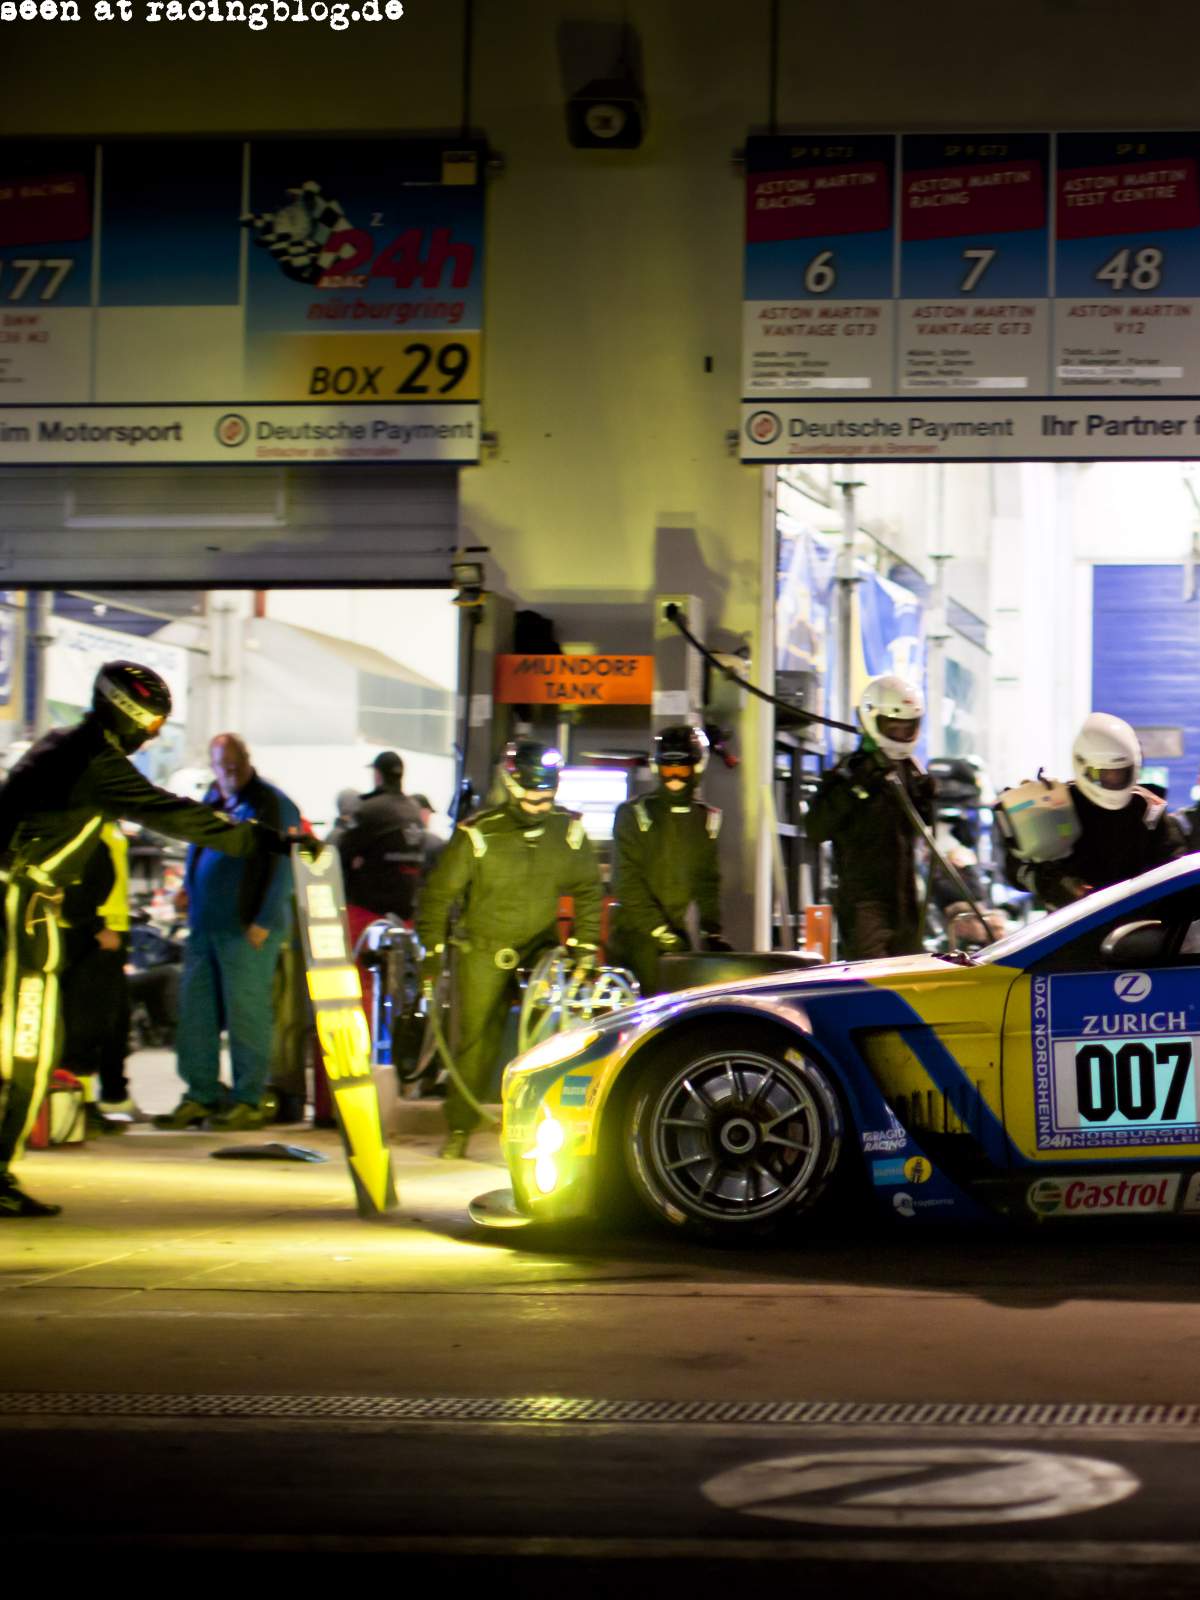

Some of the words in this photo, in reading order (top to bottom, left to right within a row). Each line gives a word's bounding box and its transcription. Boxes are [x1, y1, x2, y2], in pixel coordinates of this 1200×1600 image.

[756, 178, 809, 195] ASTON
[815, 171, 879, 189] MARTIN
[909, 177, 962, 192] ASTON
[968, 170, 1032, 187] MARTIN
[1063, 175, 1118, 191] ASTON
[1123, 169, 1187, 186] MARTIN
[756, 194, 816, 209] RACING
[910, 192, 970, 207] RACING
[1067, 191, 1107, 205] TEST
[1113, 185, 1177, 202] CENTRE
[325, 228, 476, 290] 24h
[960, 248, 997, 292] 7
[1095, 246, 1165, 292] 48
[803, 249, 836, 294] 6
[308, 298, 466, 326] nürburgring
[757, 307, 813, 320] ASTON
[817, 306, 882, 319] MARTIN
[912, 306, 967, 319] ASTON
[971, 305, 1036, 318] MARTIN
[1068, 305, 1123, 318] ASTON
[1128, 304, 1193, 317] MARTIN
[762, 323, 837, 338] VANTAGE
[917, 322, 992, 337] VANTAGE
[1112, 321, 1147, 335] V12
[309, 366, 385, 396] BOX
[397, 343, 469, 395] 29
[38, 420, 183, 447] Motorsport
[256, 420, 366, 442] Deutsche
[371, 419, 474, 446] Payment
[788, 417, 900, 439] Deutsche
[908, 417, 1014, 442] Payment
[1041, 415, 1077, 436] Ihr
[1086, 414, 1189, 437] Partner
[544, 682, 604, 700] TANK
[1034, 975, 1047, 1018] ADAC
[1081, 1012, 1187, 1035] ZURICH
[1035, 1024, 1051, 1134] NORDRHEIN
[1074, 1041, 1193, 1122] 007
[1039, 1134, 1073, 1149] 24h
[1064, 1178, 1169, 1211] Castrol
